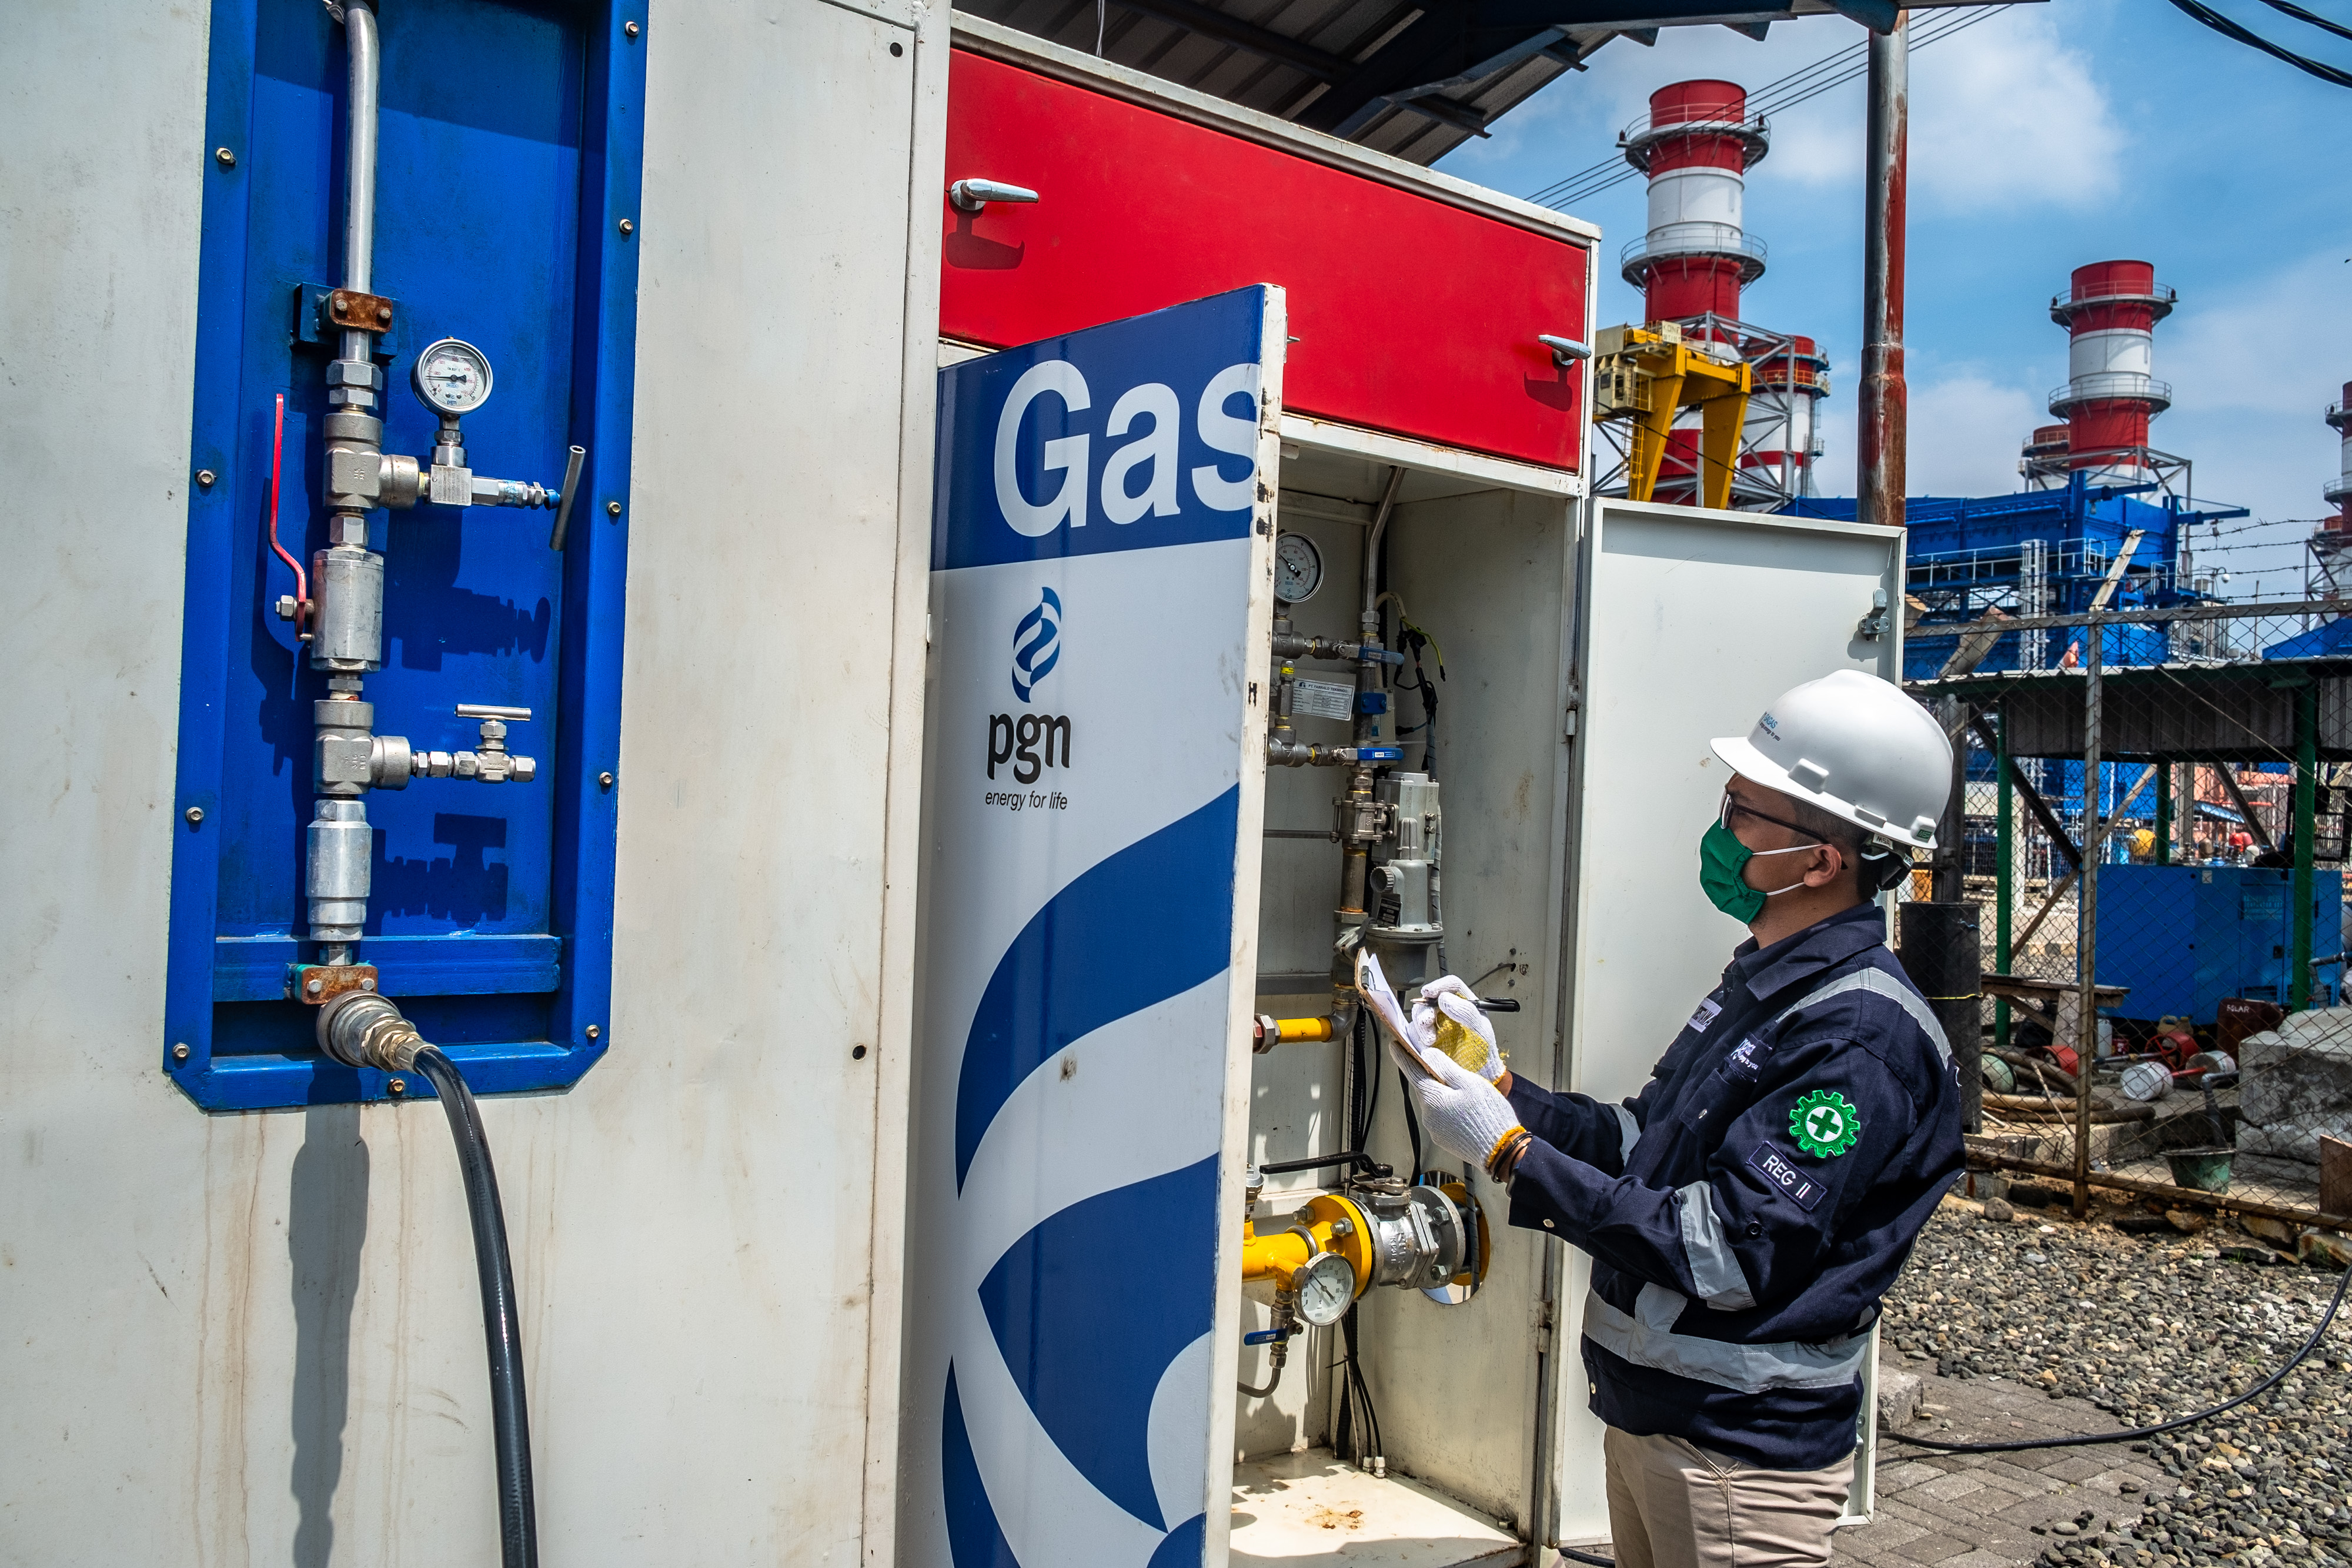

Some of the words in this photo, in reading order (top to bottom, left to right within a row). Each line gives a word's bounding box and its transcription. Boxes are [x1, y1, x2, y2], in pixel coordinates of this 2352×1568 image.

[994, 360, 1261, 537] Gas
[987, 713, 1071, 784] pgn
[985, 792, 1027, 811] energy
[1029, 790, 1047, 808] for
[1049, 791, 1068, 810] life
[1876, 836, 1891, 847] MSA
[1762, 1154, 1796, 1185] REG
[1795, 1182, 1811, 1199] II
